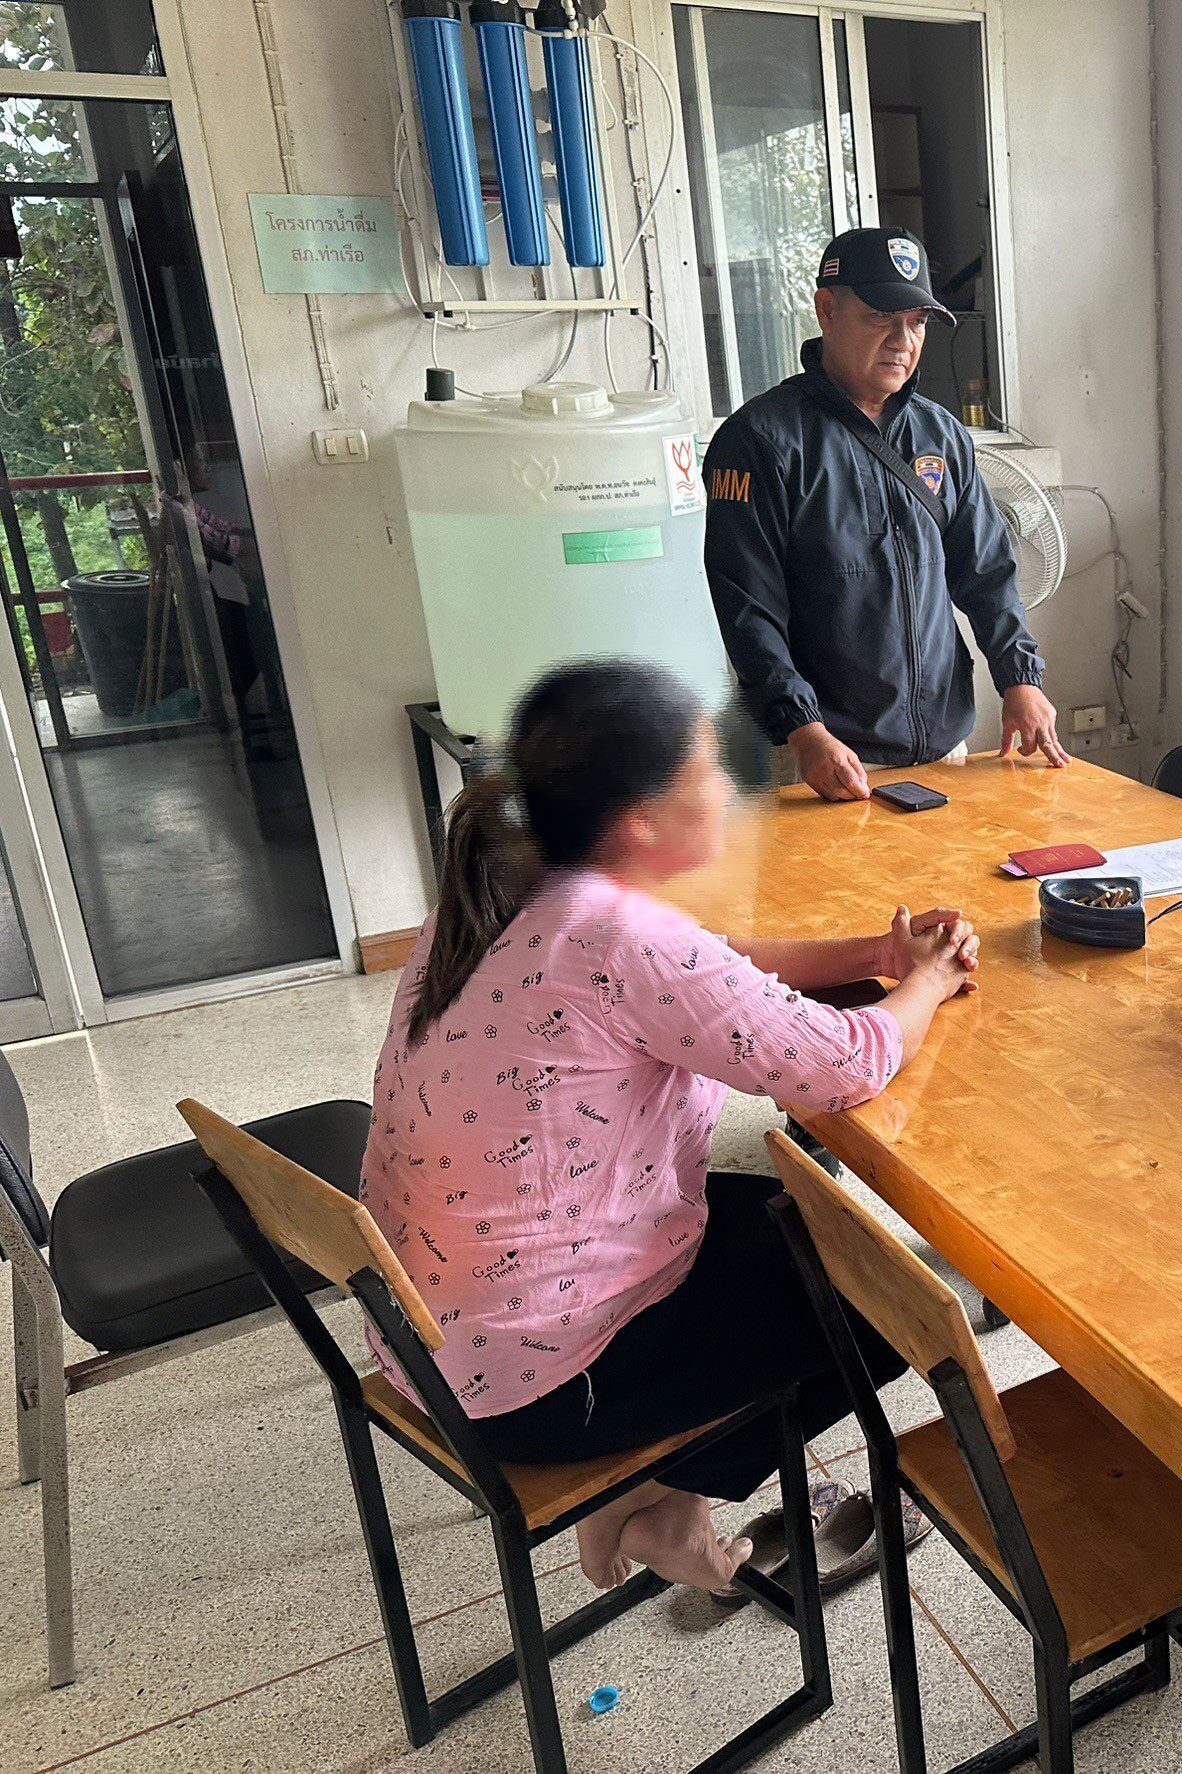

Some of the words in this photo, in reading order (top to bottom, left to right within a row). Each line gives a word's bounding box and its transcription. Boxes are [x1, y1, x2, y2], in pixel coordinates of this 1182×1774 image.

[265, 208, 377, 232] โครงการน้ำดื่ม
[291, 243, 364, 262] สภ.ท่าเรือ
[526, 1013, 555, 1035] Good
[540, 1022, 571, 1043] Times
[742, 1033, 755, 1060] Times
[496, 1066, 520, 1085] Big
[512, 1069, 546, 1091] Good
[523, 1074, 561, 1097] Times
[575, 1101, 610, 1124] Welcome
[484, 1140, 520, 1163] Good
[497, 1145, 534, 1168] Times
[418, 1226, 448, 1263] Welcome
[472, 1254, 506, 1278] Good
[484, 1260, 520, 1283] Times
[440, 1309, 461, 1326] Big
[461, 1382, 491, 1403] Times
